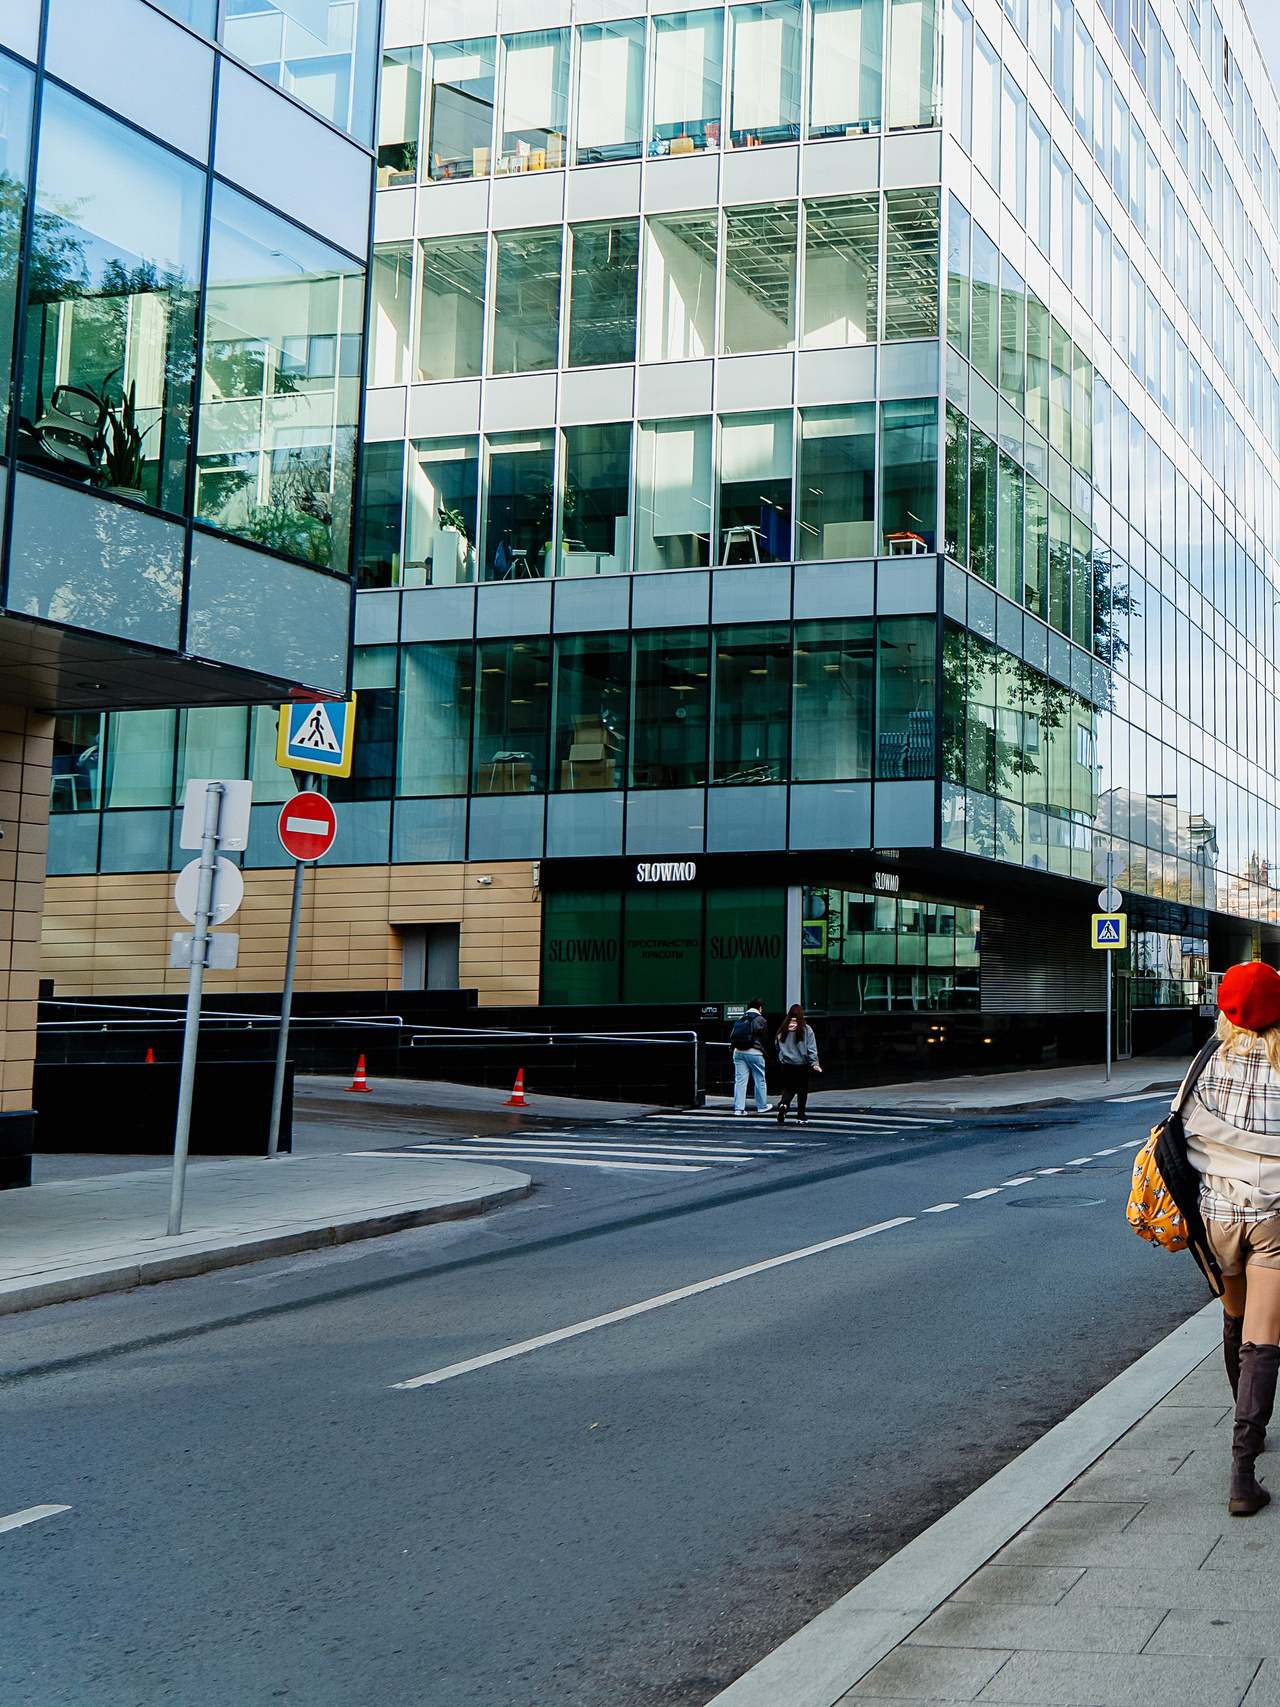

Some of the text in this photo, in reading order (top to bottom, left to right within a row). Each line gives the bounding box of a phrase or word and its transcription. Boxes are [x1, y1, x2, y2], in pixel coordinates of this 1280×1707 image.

[637, 862, 696, 882] SLOWMO
[874, 871, 899, 892] SLOWMO
[549, 938, 617, 962] SLOWMO
[627, 938, 699, 949] ПРОСТРАНСТВО
[710, 934, 781, 959] SLOWMO
[641, 950, 684, 960] КРАСОТЫ
